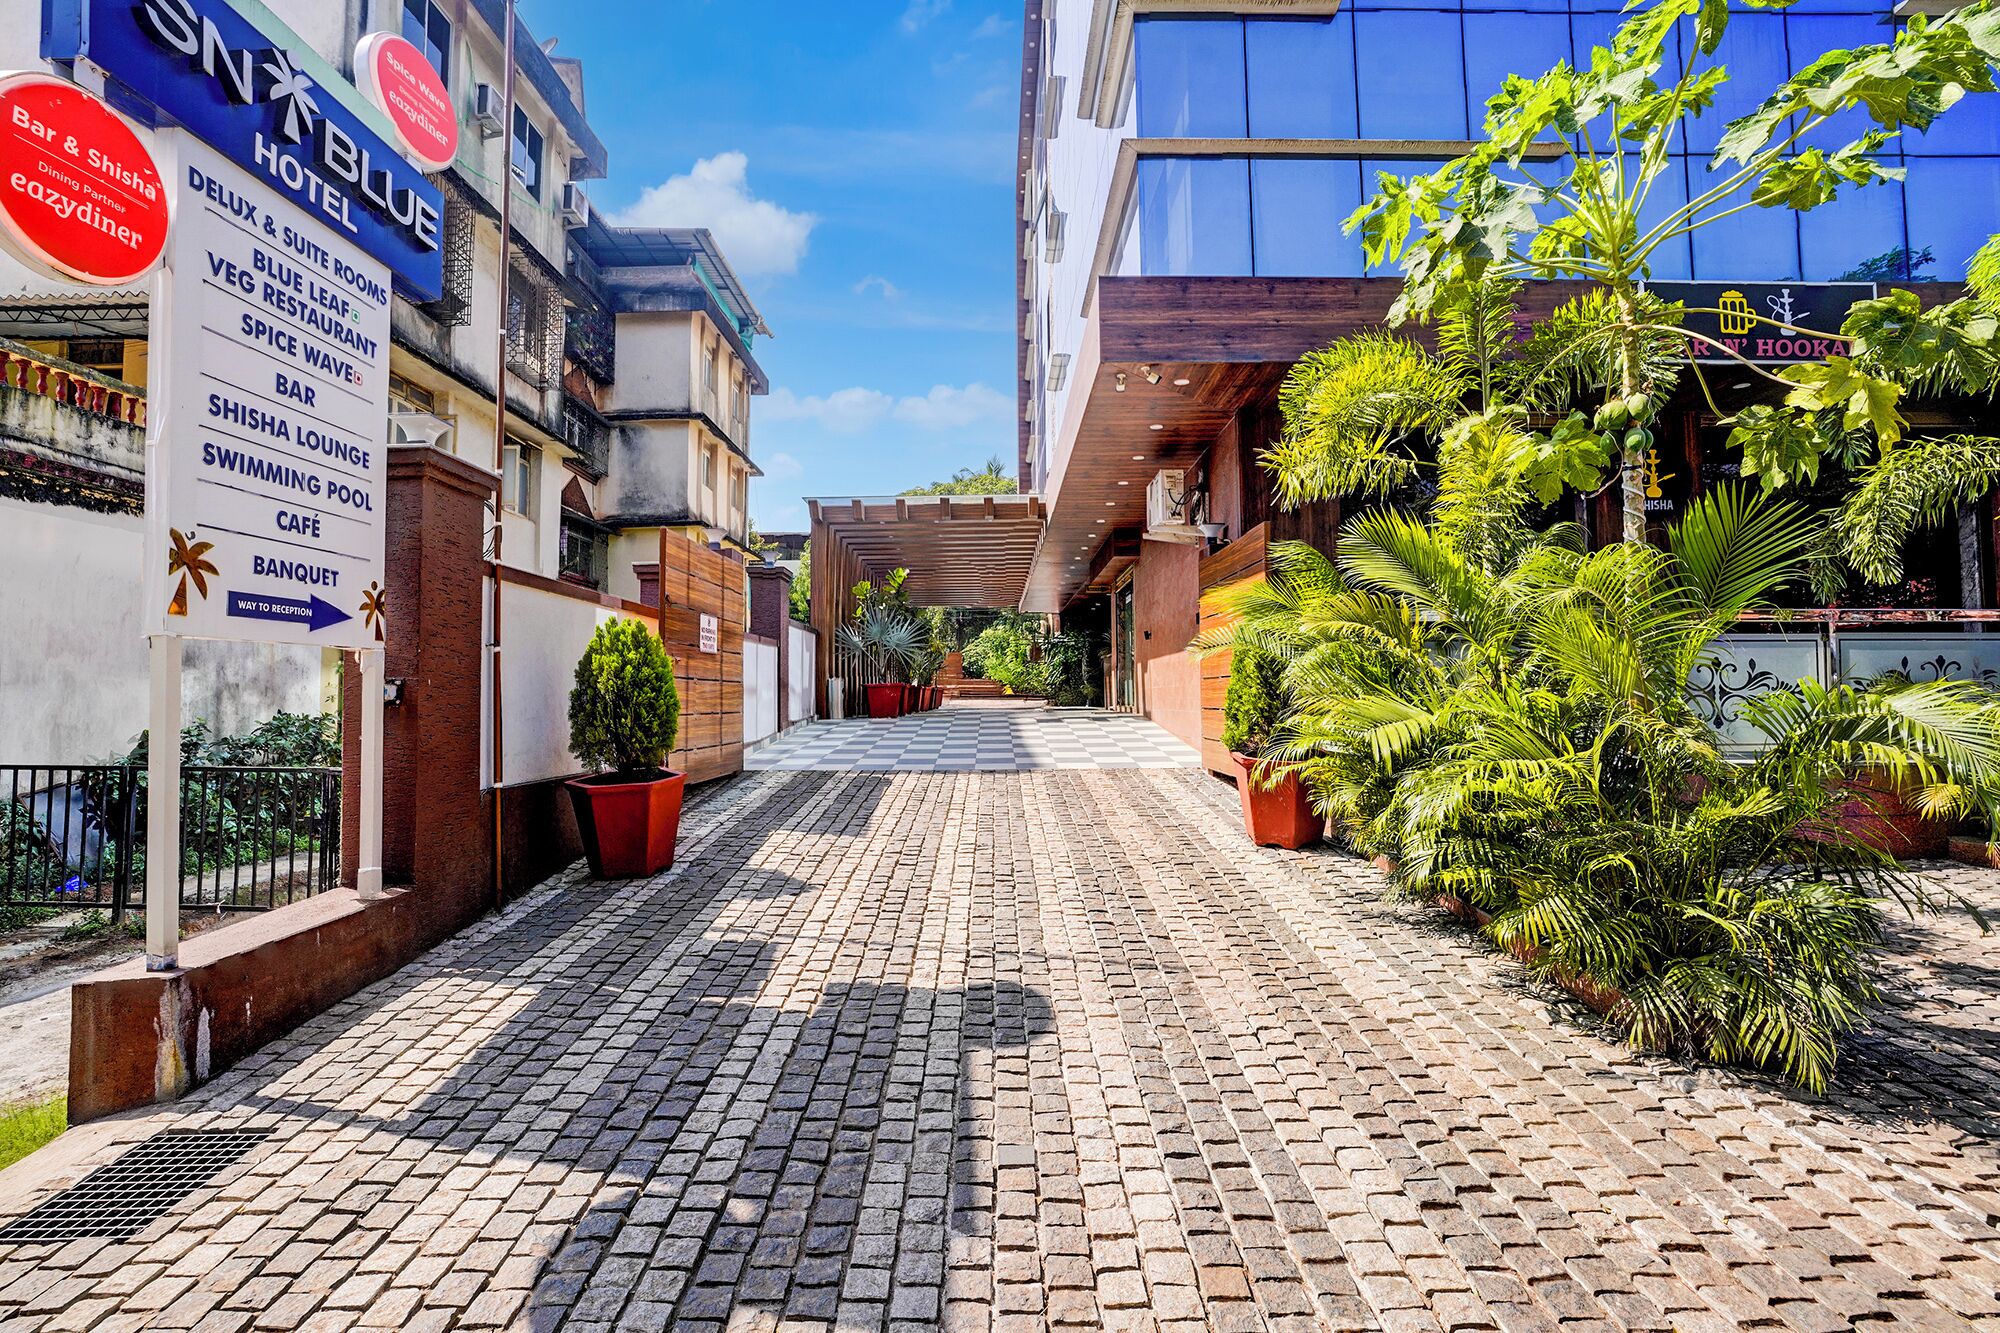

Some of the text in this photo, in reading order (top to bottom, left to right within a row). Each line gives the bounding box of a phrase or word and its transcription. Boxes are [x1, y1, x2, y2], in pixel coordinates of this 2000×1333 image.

[386, 51, 446, 112] Spice Wave
[12, 104, 156, 202] Bar & Shisha
[389, 91, 448, 146] eazydiner
[10, 172, 143, 250] eazydiner
[38, 161, 126, 214] Dining Partner
[255, 132, 358, 234] HOTEL
[324, 118, 439, 251] BLUE
[188, 165, 387, 306] DELUX & SUITE ROOMS
[206, 250, 377, 359] VEG RESTAURANT
[253, 248, 350, 318] BLUE LEAF
[241, 313, 353, 384] SPICE WAVE
[275, 372, 316, 407] BAR
[208, 393, 370, 470] SHISHA LOUNGE
[202, 442, 372, 511] SWIMMING POOL
[1644, 500, 1674, 510] HISHA
[276, 510, 320, 538] CAFÉ
[253, 555, 339, 588] BANQUET
[238, 600, 313, 617] WAY TO RECEPTION
